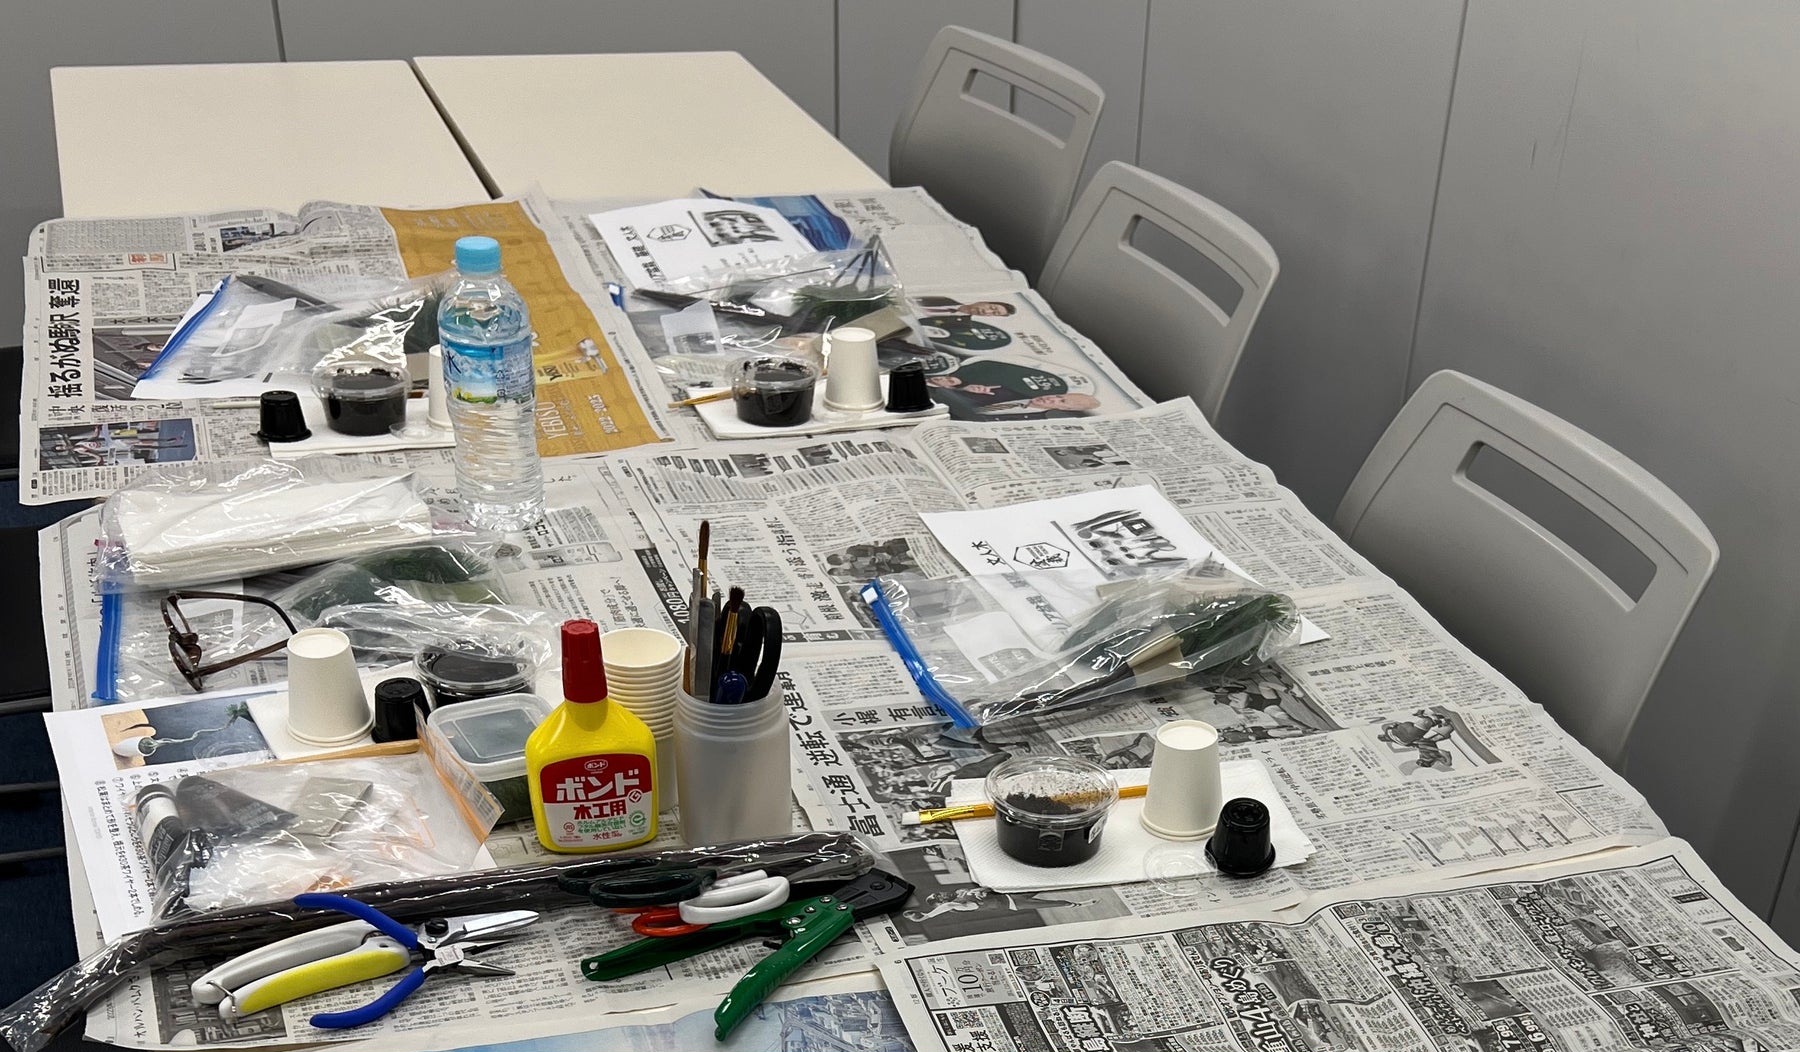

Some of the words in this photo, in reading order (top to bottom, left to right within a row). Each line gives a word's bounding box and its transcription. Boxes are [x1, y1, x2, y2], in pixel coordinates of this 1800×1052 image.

[48, 277, 81, 309] 奪還
[556, 769, 639, 801] ボンド
[574, 800, 627, 820] 木工用
[825, 773, 885, 836] 富士通
